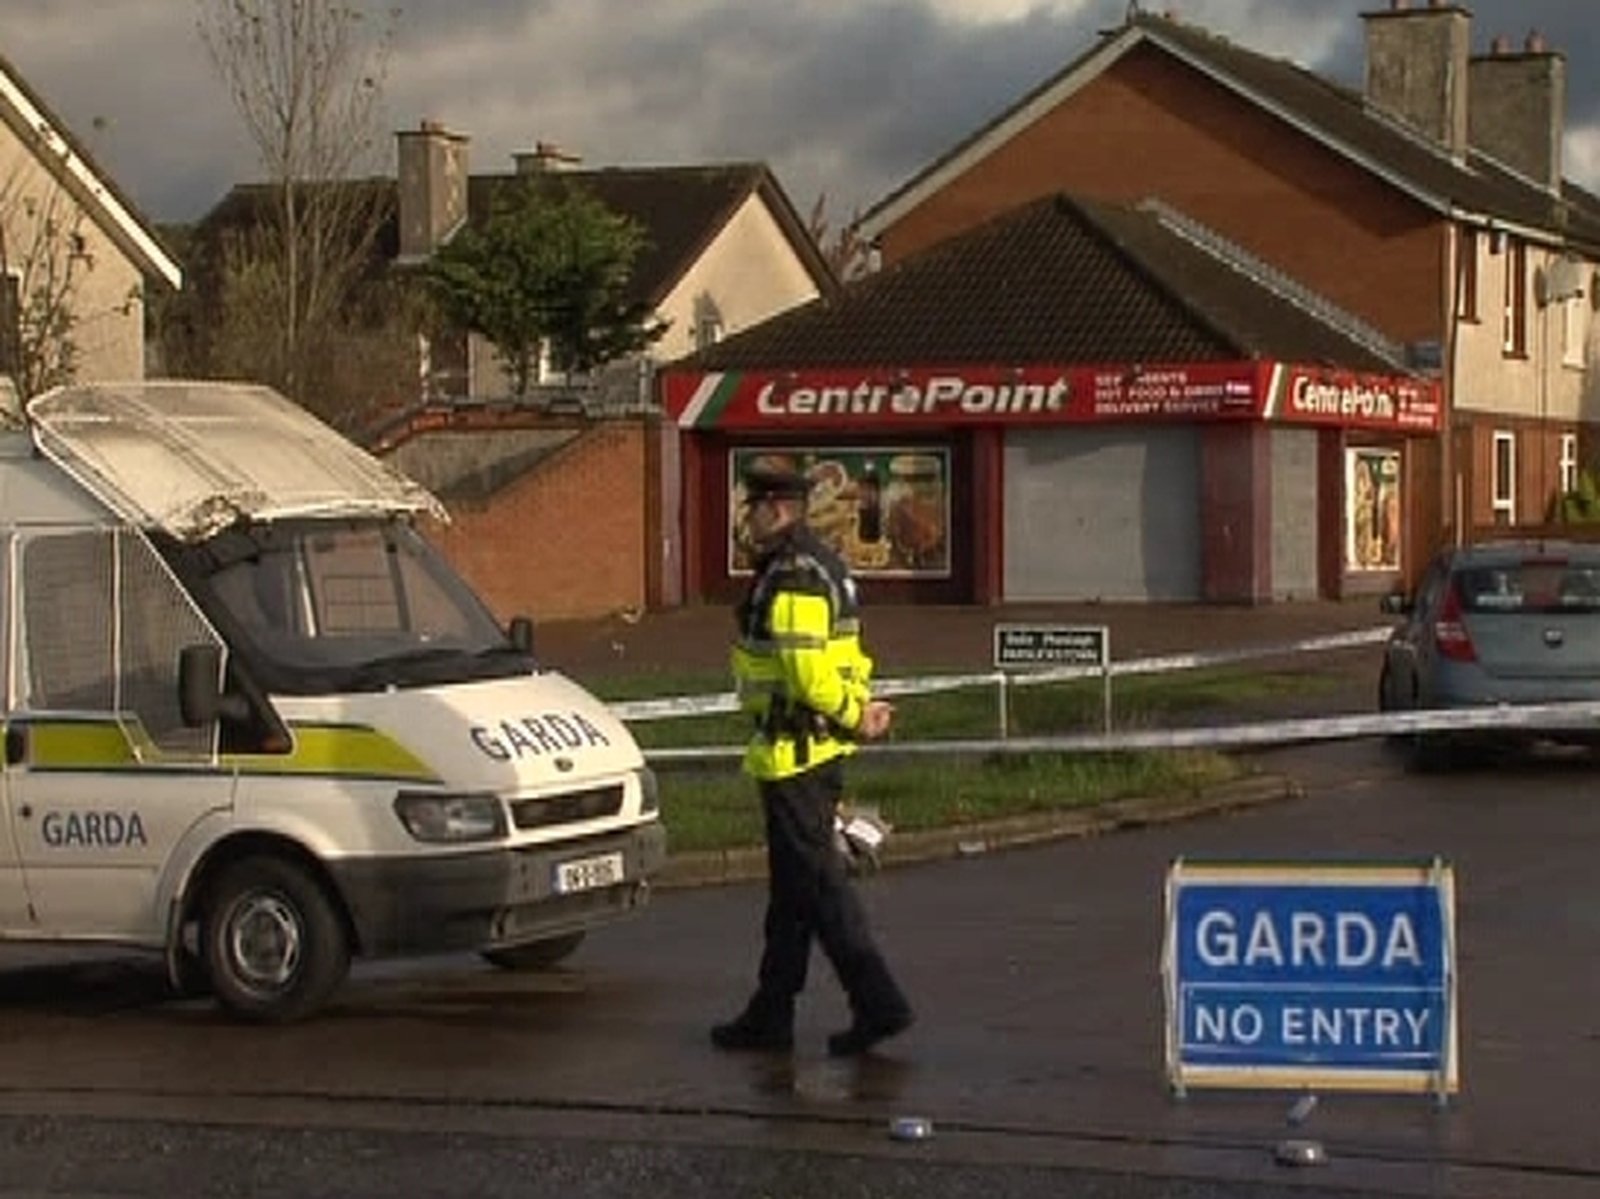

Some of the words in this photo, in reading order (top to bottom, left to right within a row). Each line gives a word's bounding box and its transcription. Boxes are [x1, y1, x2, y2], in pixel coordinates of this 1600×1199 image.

[470, 712, 610, 760] GARDA
[42, 811, 148, 846] GARDA
[1196, 910, 1423, 967] GARDA
[1195, 1004, 1264, 1044] NO
[1282, 1006, 1431, 1045] ENTRY
